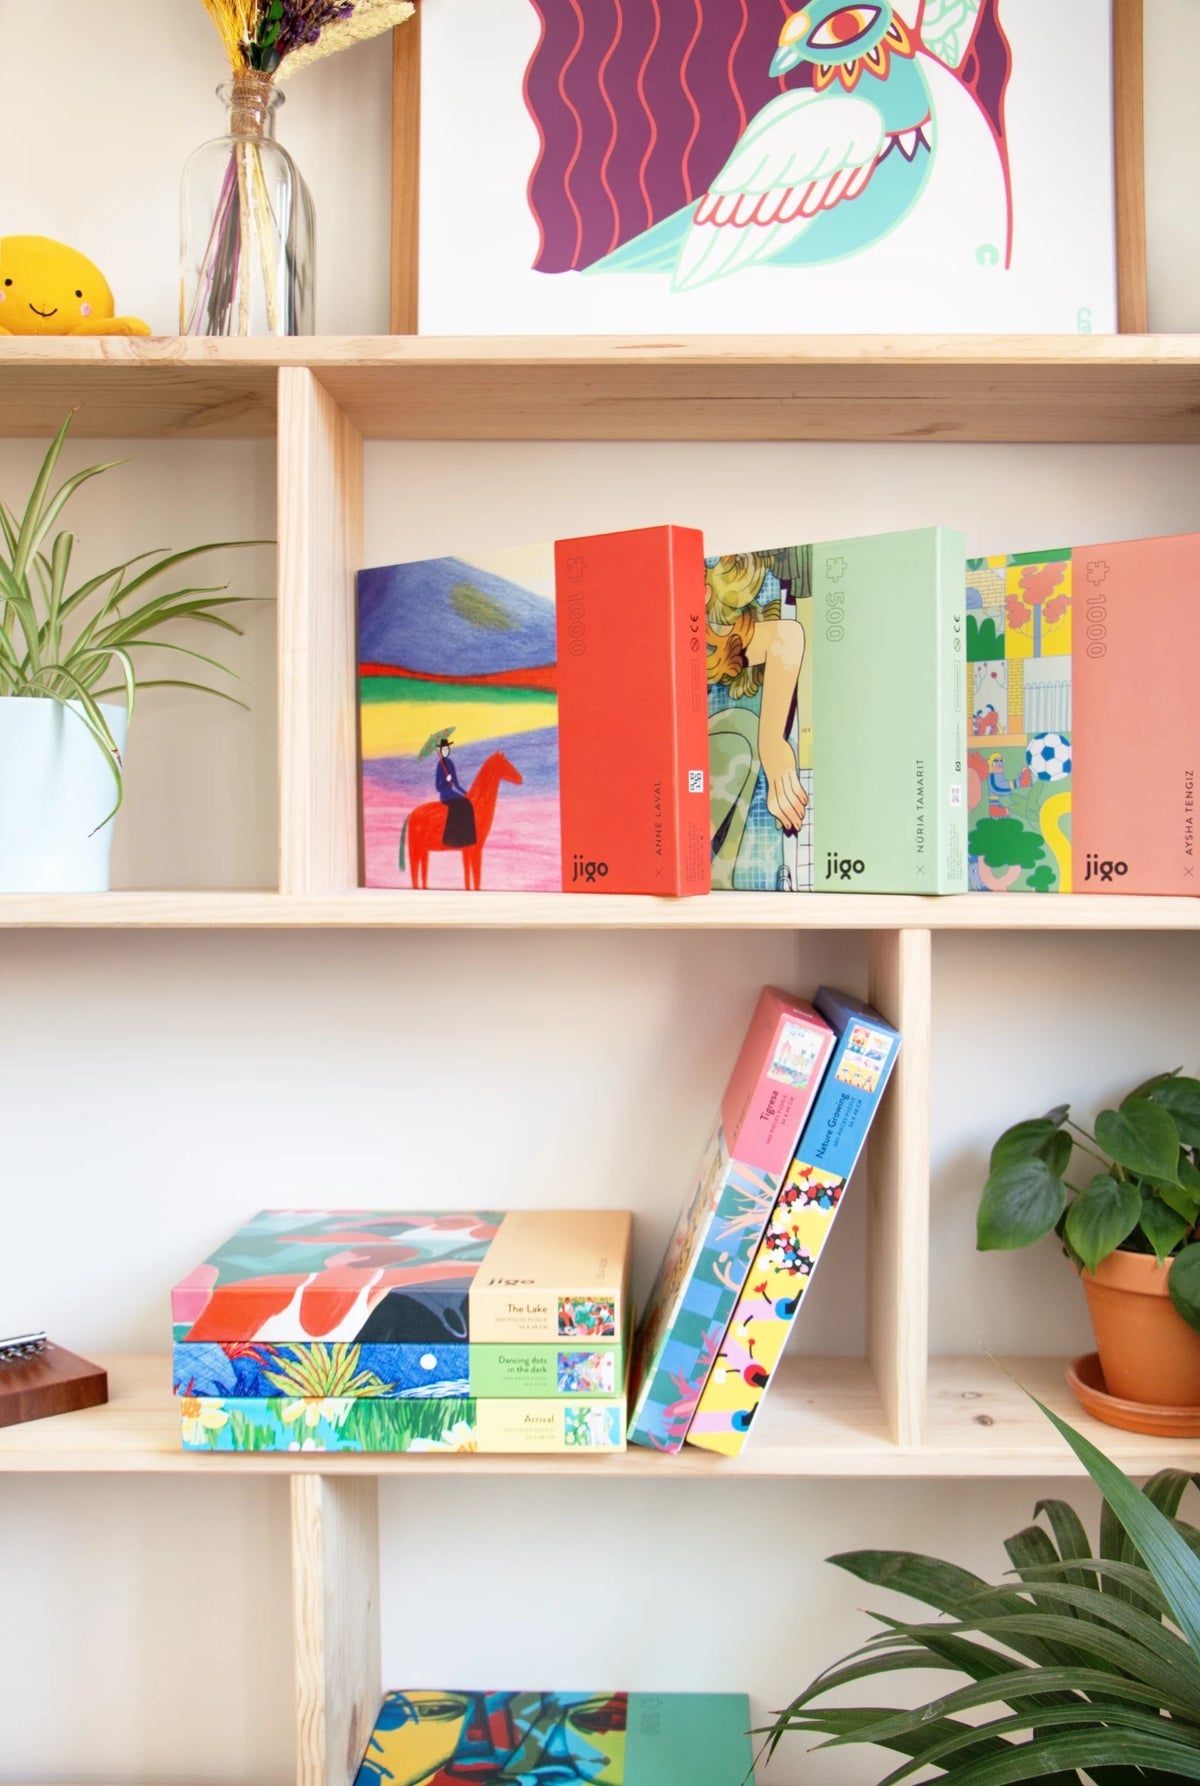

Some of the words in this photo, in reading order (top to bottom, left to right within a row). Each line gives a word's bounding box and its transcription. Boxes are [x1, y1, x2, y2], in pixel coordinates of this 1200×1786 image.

[568, 592, 586, 657] 1000
[826, 591, 845, 643] 500
[1086, 594, 1107, 659] 1000
[654, 781, 662, 818] LAVAL
[916, 759, 924, 811] TAMARIT
[1184, 770, 1194, 813] TENGIZ
[655, 821, 663, 856] ANNE
[915, 815, 924, 853] NÚRIA
[1184, 815, 1194, 856] AYSHA
[572, 855, 608, 882] jigo
[825, 852, 865, 880] jigo
[1084, 854, 1128, 882] jigo
[760, 1090, 779, 1121] Tigresa
[815, 1129, 833, 1159] Nature
[827, 1093, 850, 1128] Growing
[487, 1277, 535, 1286] jigo
[507, 1304, 524, 1313] The
[526, 1303, 548, 1313] Lake
[498, 1355, 529, 1366] Dancing
[516, 1365, 528, 1373] the
[530, 1365, 547, 1373] dark
[523, 1414, 554, 1423] Arrival
